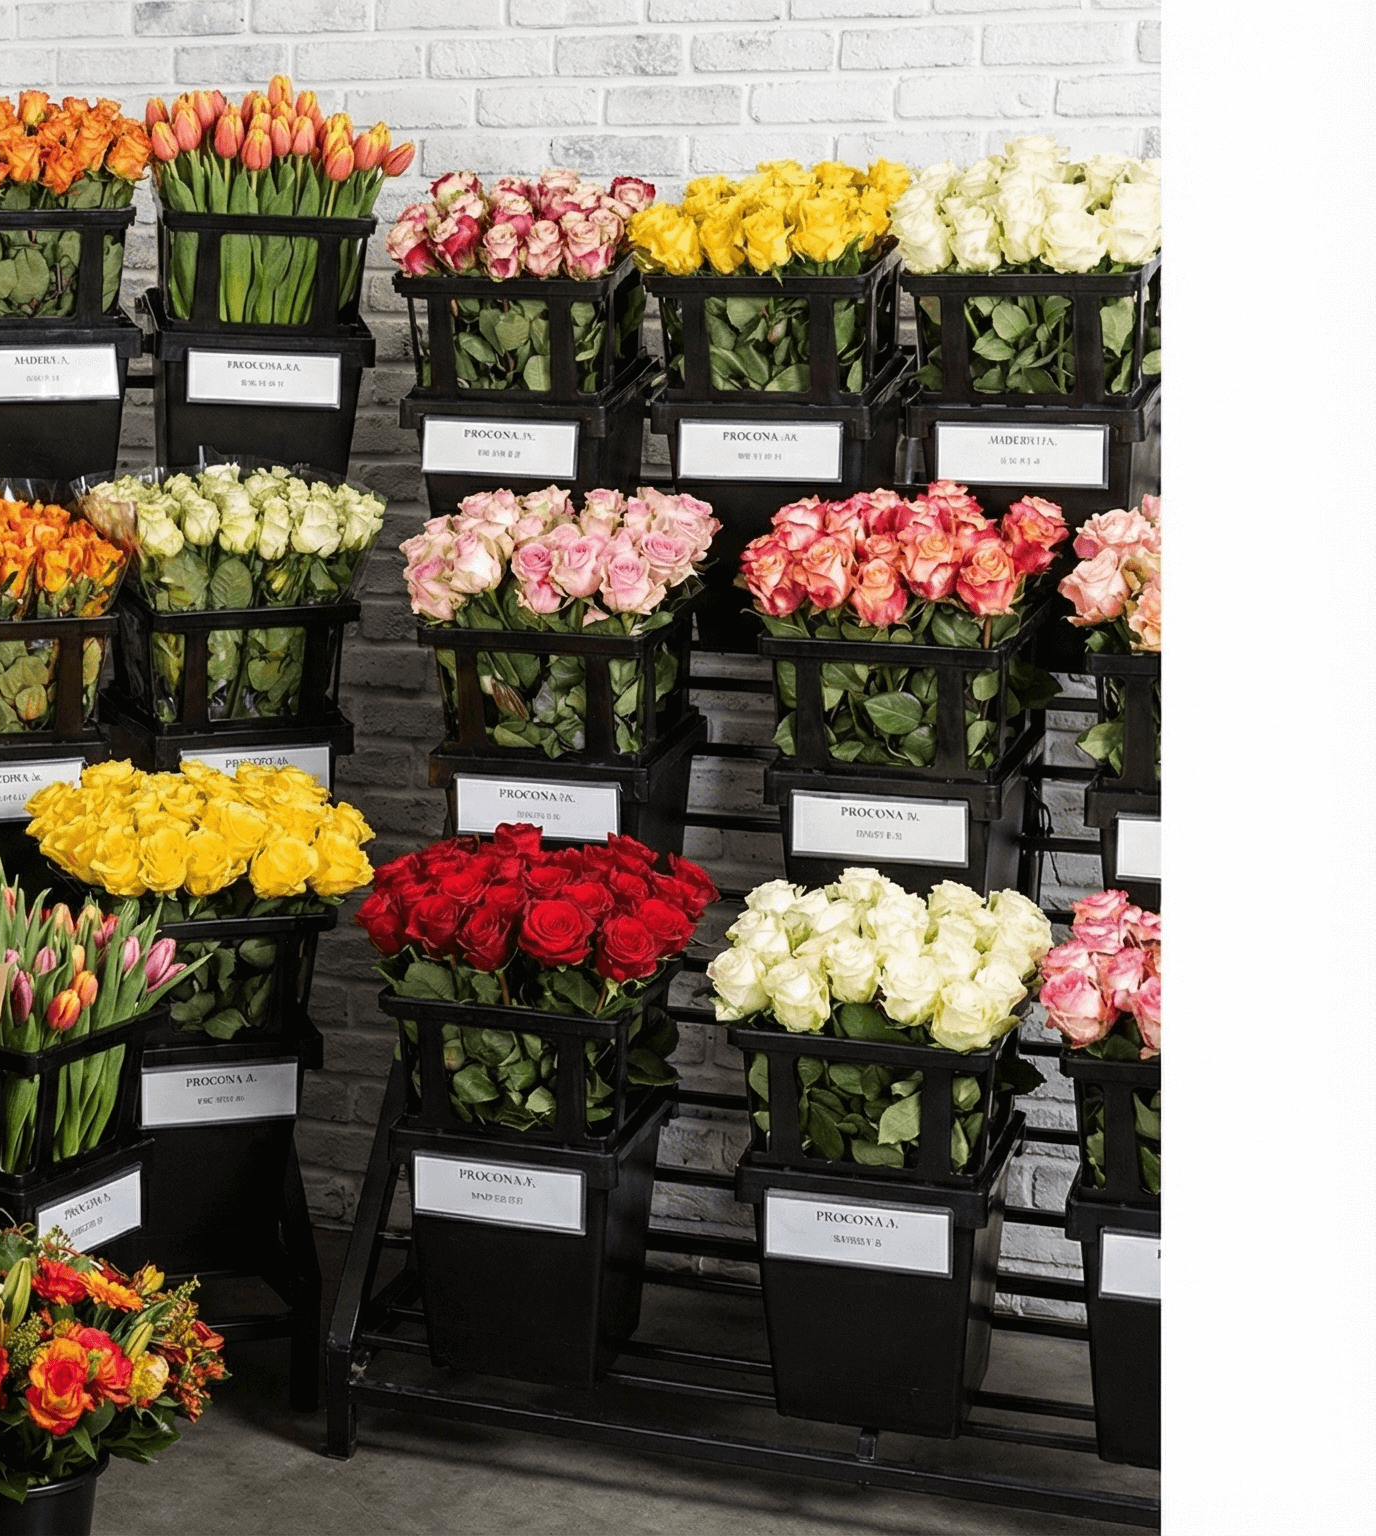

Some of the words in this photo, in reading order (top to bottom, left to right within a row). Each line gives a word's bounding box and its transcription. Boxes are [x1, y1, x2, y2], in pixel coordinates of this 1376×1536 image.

[841, 806, 903, 820] PROCONA
[186, 1075, 243, 1087] PROCONA
[816, 1210, 883, 1228] PROCONA
